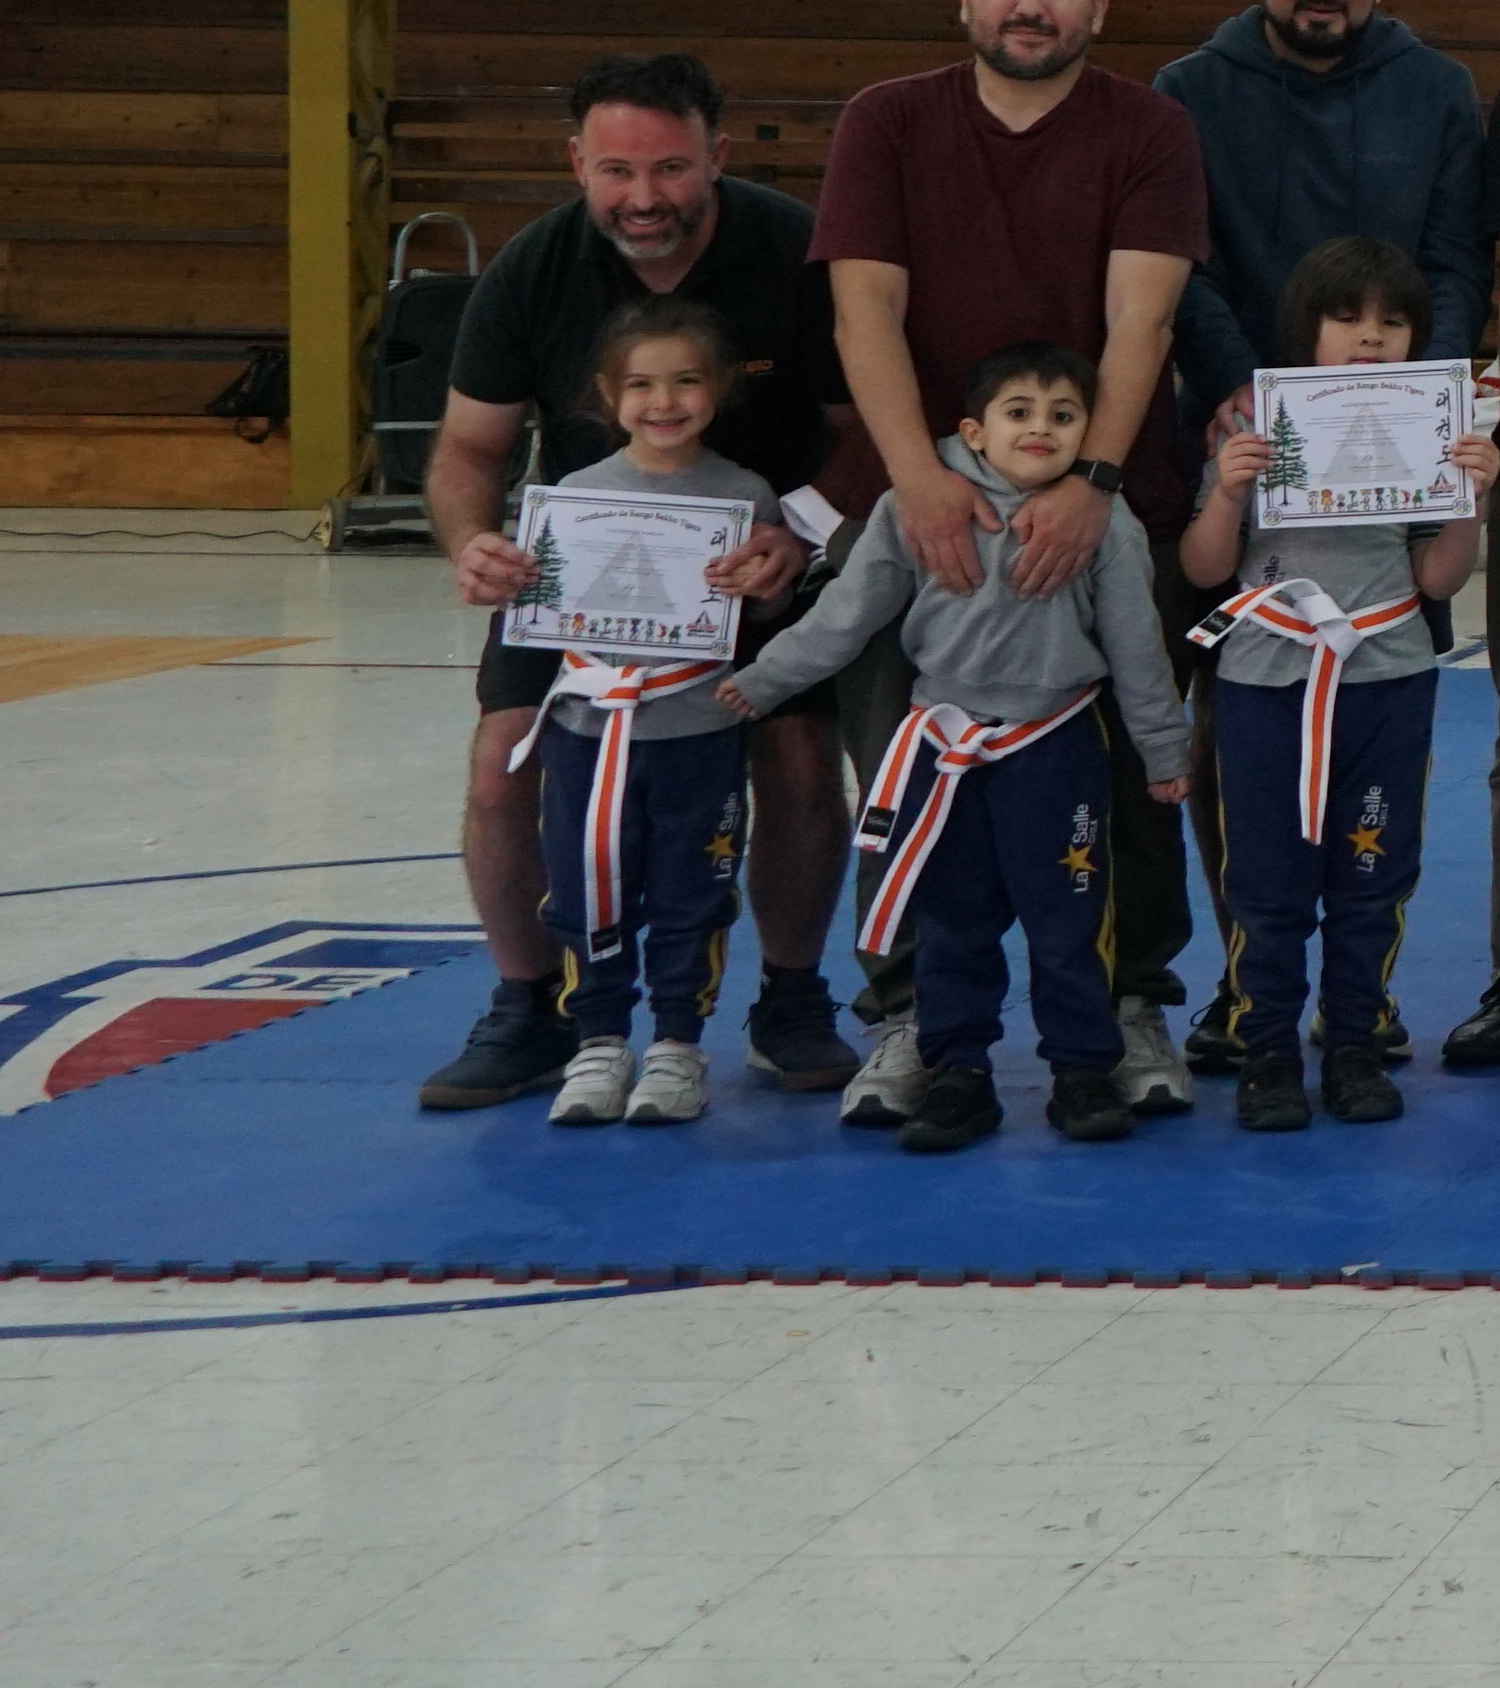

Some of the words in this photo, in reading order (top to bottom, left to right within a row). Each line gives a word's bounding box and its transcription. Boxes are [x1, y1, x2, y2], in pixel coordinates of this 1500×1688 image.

[1361, 786, 1381, 825] Salle
[1072, 804, 1089, 844] Salle
[715, 858, 732, 879] La
[1357, 853, 1375, 872] La
[1074, 871, 1089, 892] La
[201, 973, 376, 992] DE
